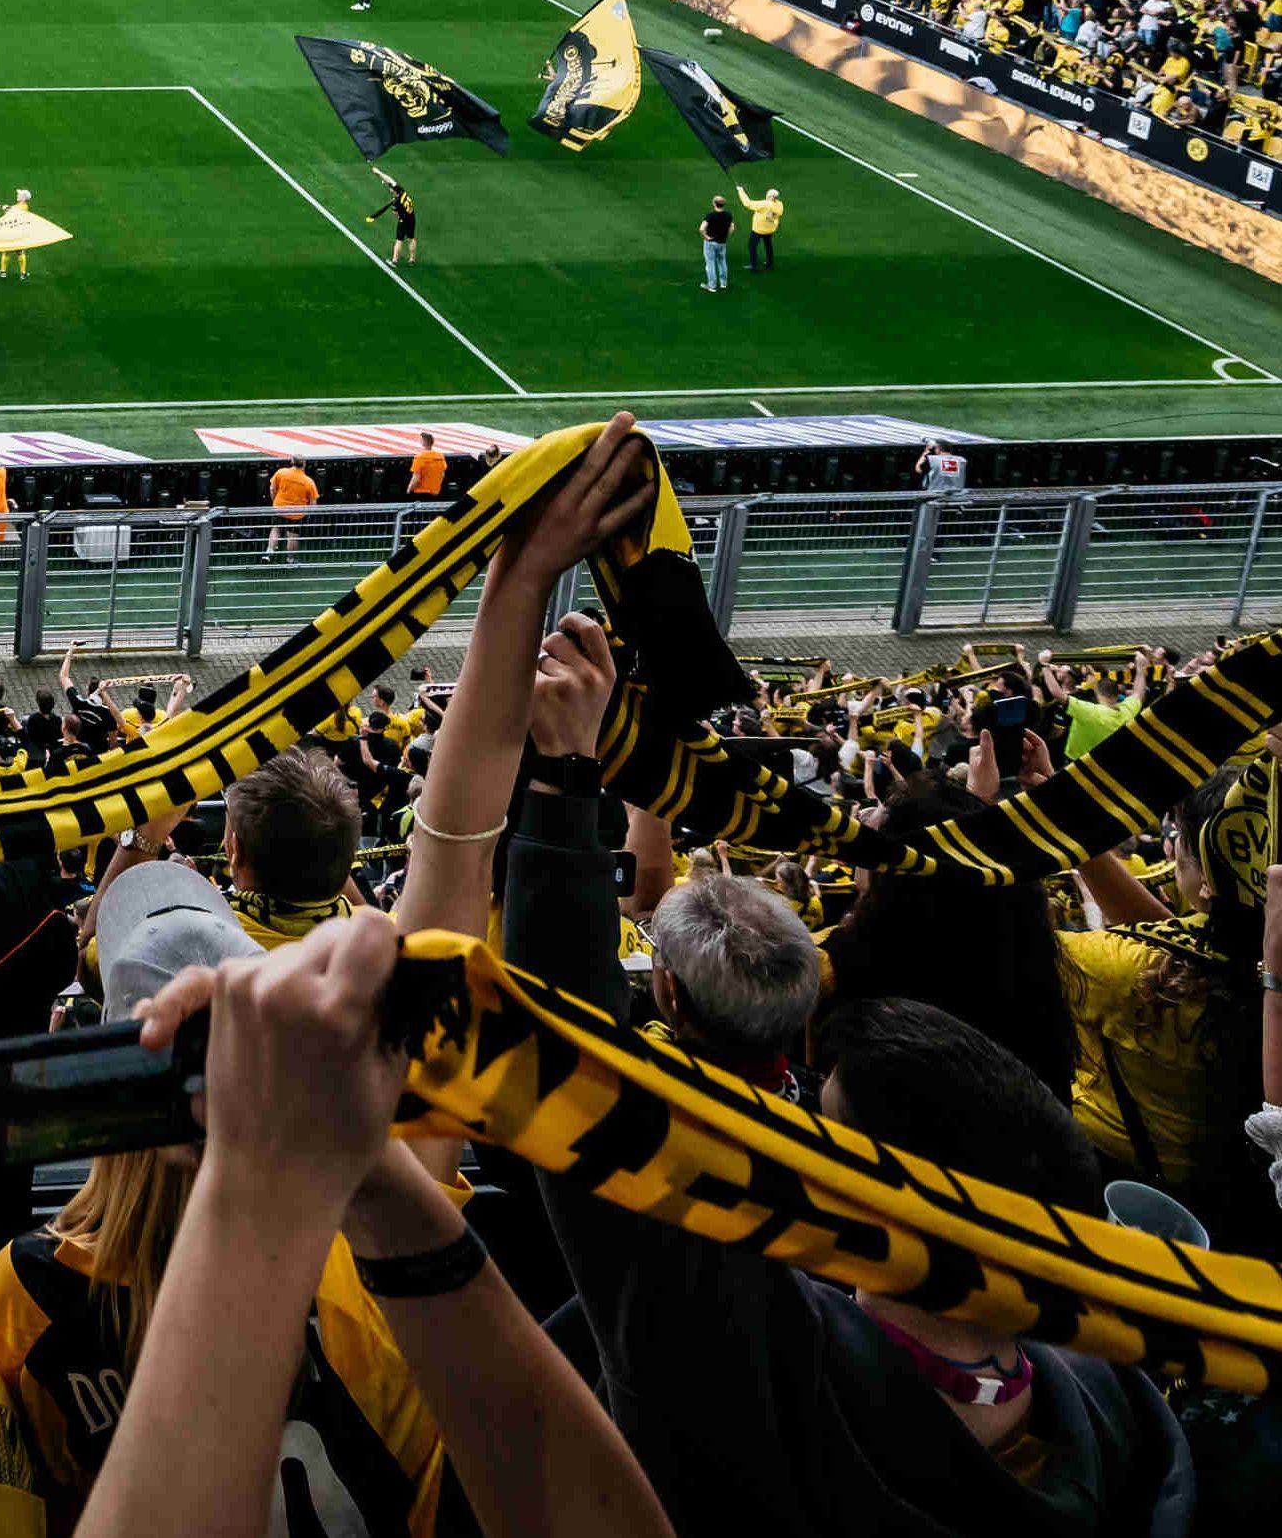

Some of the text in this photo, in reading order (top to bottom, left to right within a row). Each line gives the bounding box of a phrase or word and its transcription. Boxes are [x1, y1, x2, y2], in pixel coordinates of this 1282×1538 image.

[875, 13, 915, 38] EVONIK
[1011, 68, 1083, 108] SIGNAL IDUNA
